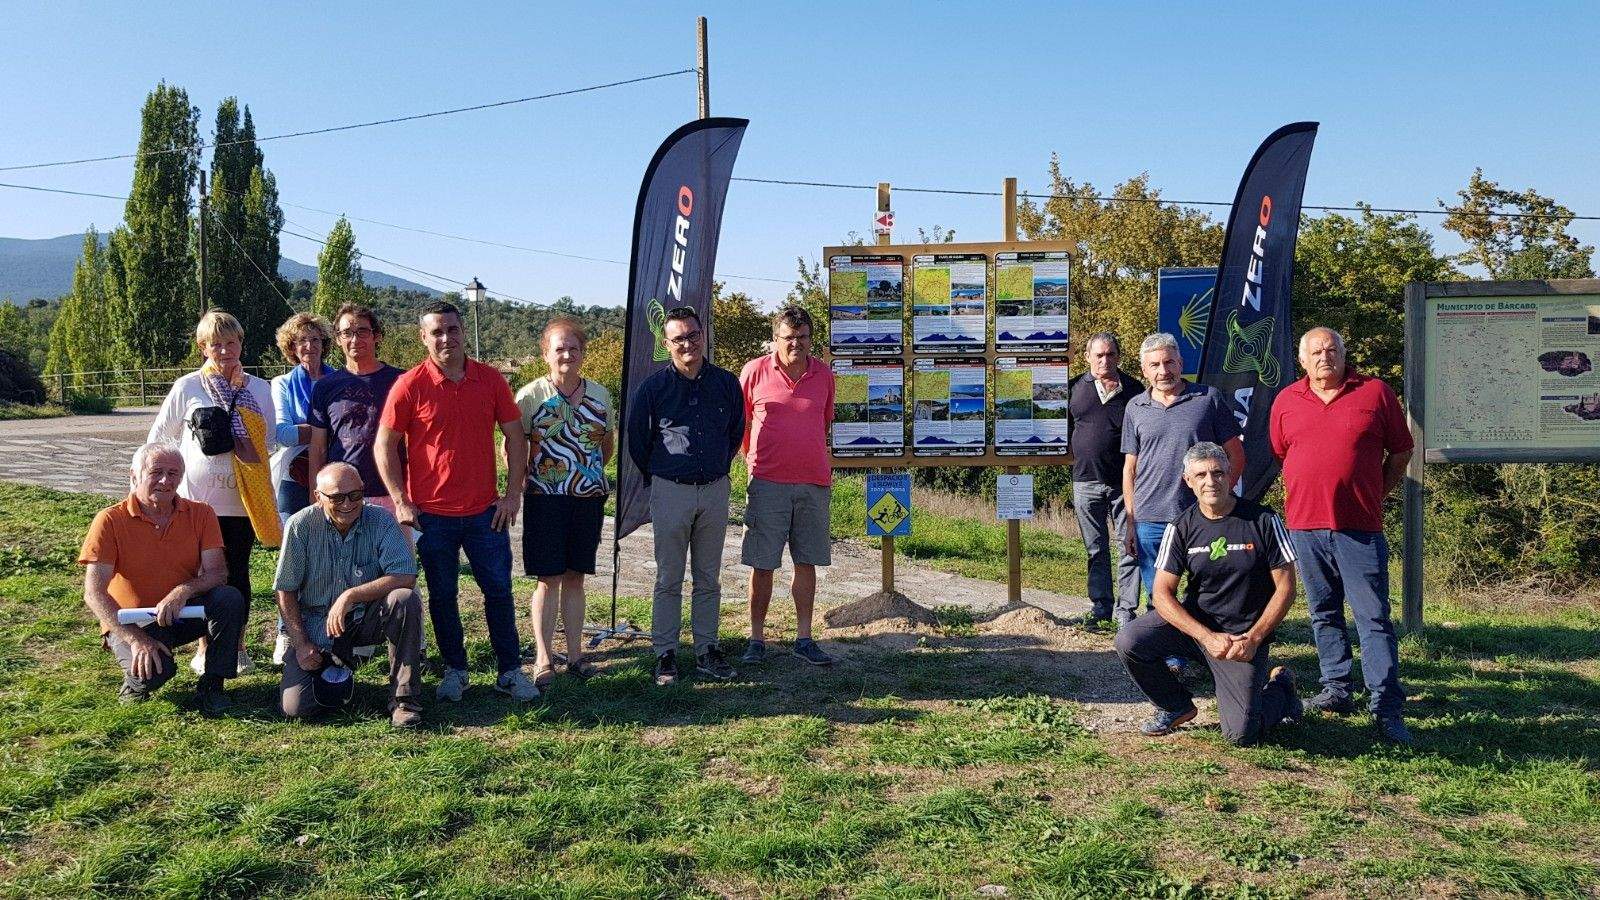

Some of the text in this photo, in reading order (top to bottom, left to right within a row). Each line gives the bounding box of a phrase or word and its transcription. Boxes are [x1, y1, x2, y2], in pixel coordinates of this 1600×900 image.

[667, 185, 694, 302] ZERO
[1241, 195, 1272, 312] ZERO
[1437, 303, 1482, 311] MUNICIPIO
